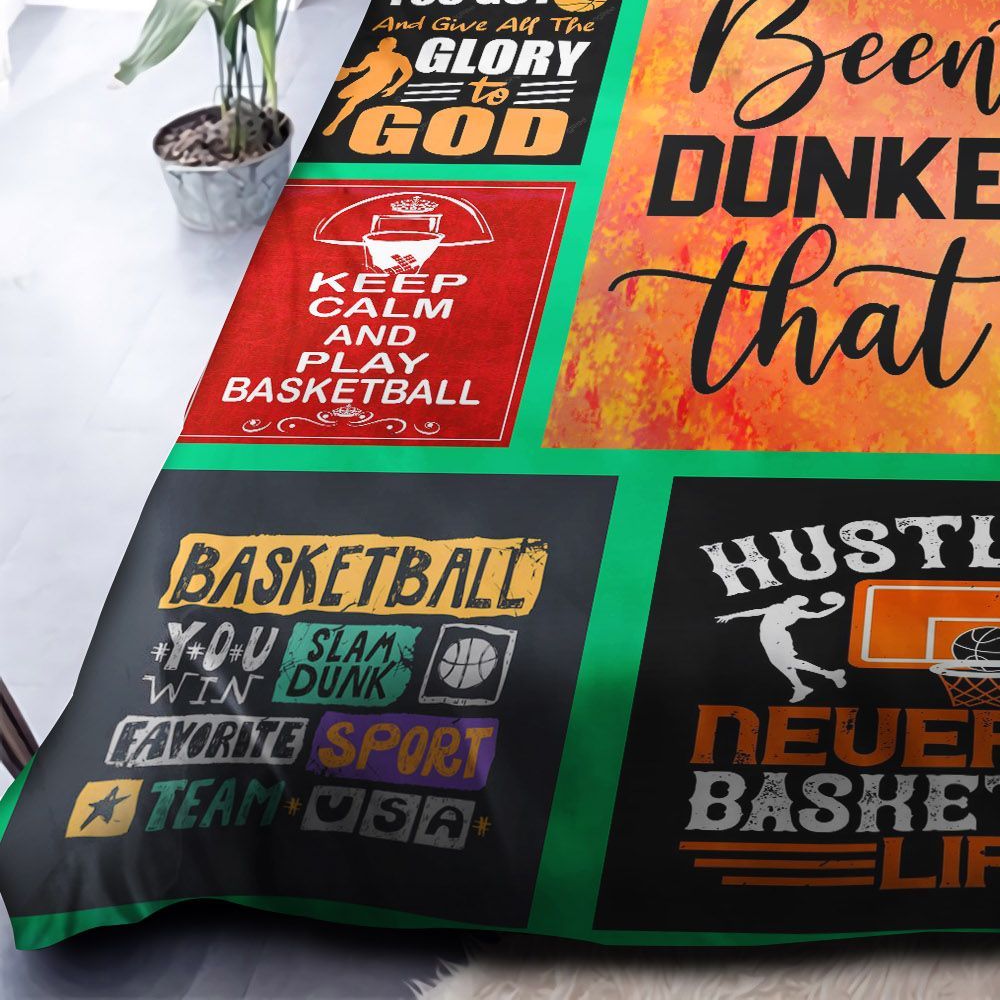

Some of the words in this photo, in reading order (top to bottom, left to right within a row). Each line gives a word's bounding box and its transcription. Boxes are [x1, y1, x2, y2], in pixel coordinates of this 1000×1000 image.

[372, 16, 423, 32] And
[432, 16, 489, 32] Give
[496, 16, 539, 36] All
[550, 16, 596, 33] The
[414, 37, 592, 77] GLORY
[468, 75, 510, 105] to
[348, 105, 569, 156] GOD
[308, 271, 469, 294] KEEP
[308, 297, 454, 319] CALM
[323, 325, 417, 347] AND
[296, 351, 430, 375] PLAY
[221, 376, 480, 405] BASKETBALL
[168, 540, 528, 610] BASKETBALL
[305, 626, 399, 663] SLAM
[143, 674, 265, 706] WIN
[286, 660, 395, 700] DUNK
[111, 719, 300, 762] FAVORITE
[318, 721, 494, 780] SPORT
[144, 778, 286, 833] TEAM
